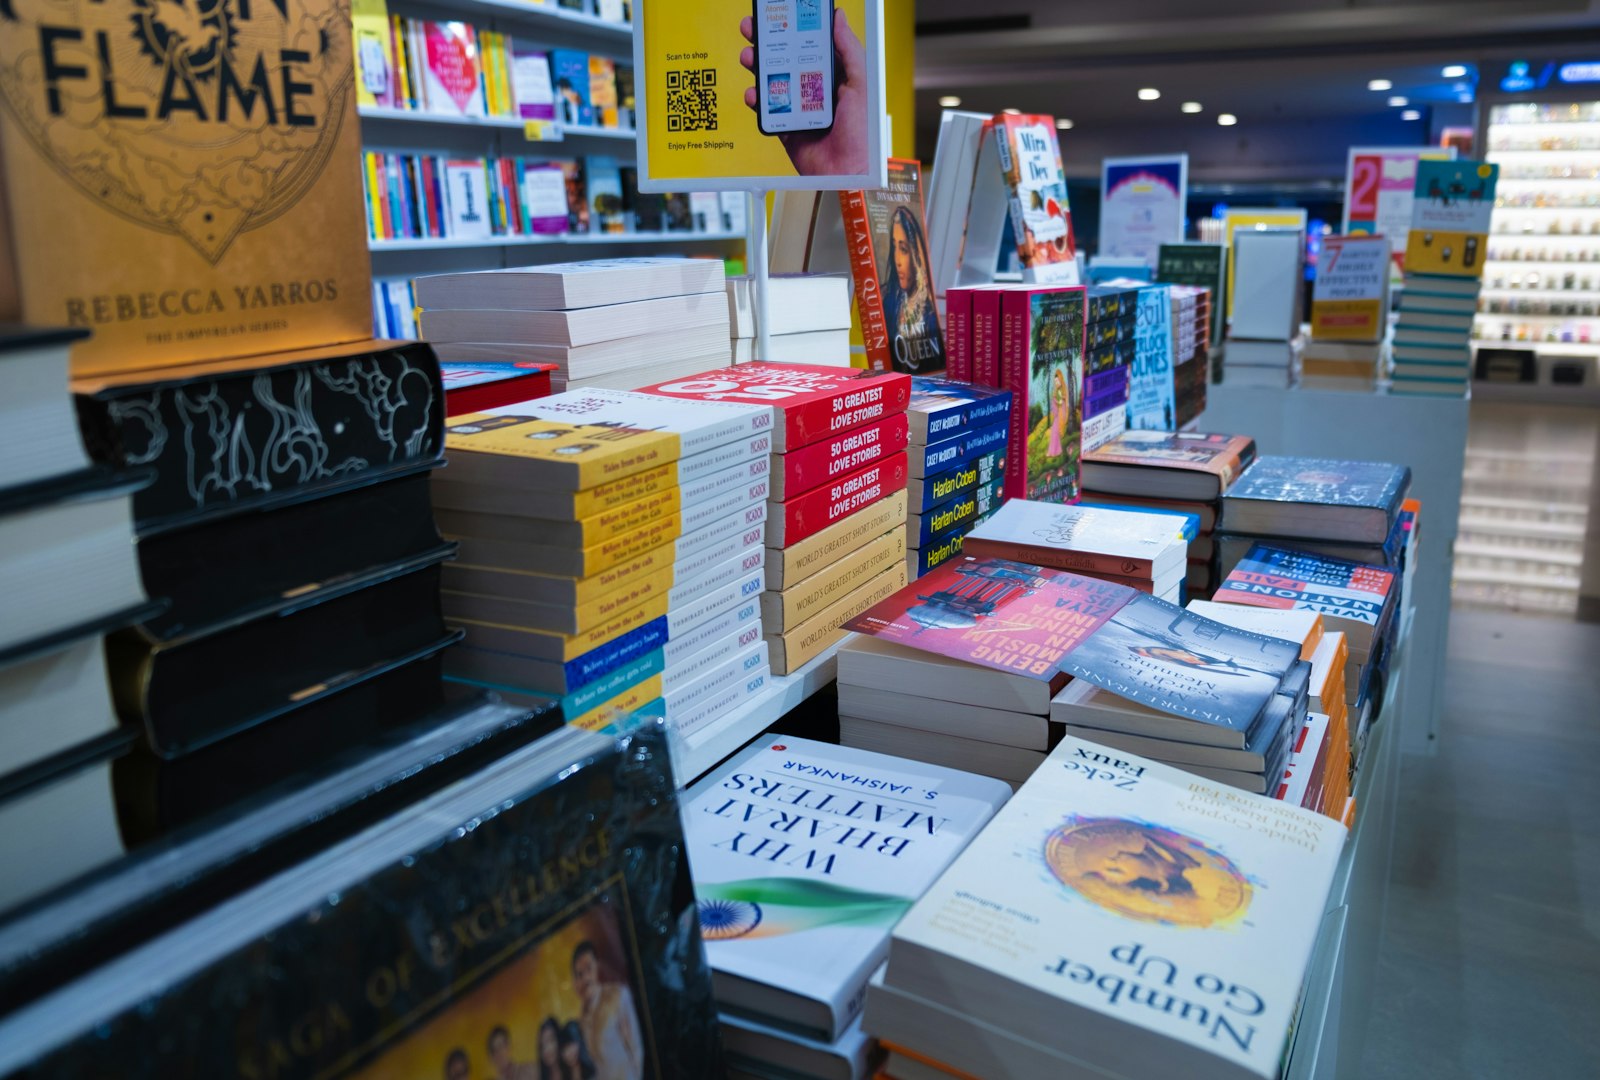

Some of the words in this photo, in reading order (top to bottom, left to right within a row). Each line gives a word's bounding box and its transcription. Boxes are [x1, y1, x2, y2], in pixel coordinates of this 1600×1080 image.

[666, 53, 683, 61] Scan
[692, 51, 708, 61] shop
[39, 25, 316, 126] FLAME
[668, 142, 686, 151] Enjoy
[687, 141, 703, 149] Free
[704, 140, 734, 150] Shipping
[1021, 132, 1046, 152] Mira
[1029, 162, 1048, 180] Dev
[1351, 161, 1378, 213] 2
[853, 218, 873, 268] LAST
[864, 278, 886, 349] QUEEN
[66, 289, 224, 327] REBECCA
[234, 279, 338, 309] YARROS
[895, 335, 940, 370] QUEEN
[1132, 351, 1168, 378] OLMES
[833, 398, 843, 412] 50
[844, 387, 883, 409] GREATEST
[752, 412, 770, 430] PICADOR
[830, 414, 852, 430] LOVE
[853, 403, 883, 423] STORIES
[930, 418, 942, 433] CASEY
[751, 436, 768, 453] PICADOR
[831, 443, 841, 457] 50
[842, 428, 880, 452] GREATEST
[1012, 392, 1020, 476] ENCHANTMENTS
[603, 461, 620, 474] Tales
[621, 457, 635, 469] from
[636, 454, 646, 464] the
[829, 458, 850, 475] LOVE
[852, 444, 882, 466] STORIES
[927, 451, 938, 467] CASEY
[831, 486, 842, 501] 50
[843, 468, 880, 495] GREATEST
[933, 478, 955, 499] Harlan
[956, 469, 976, 489] Coben
[829, 501, 850, 519] LOVE
[852, 484, 881, 508] STORIES
[931, 511, 953, 533] Harlan
[953, 500, 974, 521] Coben
[796, 548, 824, 569] WORLD'S
[824, 532, 852, 559] GREATEST
[852, 523, 870, 541] SHORT
[870, 512, 891, 530] STORIES
[928, 544, 950, 568] Harlan
[1056, 556, 1063, 566] by
[1065, 557, 1096, 569] Gandhi
[1270, 553, 1346, 570] POVERTY
[796, 586, 824, 611] WORLD'S
[824, 570, 851, 596] GREATEST
[852, 560, 870, 577] SHORT
[870, 548, 890, 567] STORIES
[1238, 573, 1299, 588] FAIL
[1269, 569, 1341, 585] ORIGINS
[1279, 560, 1385, 582] PROSPERITY
[1352, 567, 1386, 577] AND
[1363, 579, 1382, 587] OF
[742, 578, 760, 596] PICADOR
[1088, 593, 1114, 607] US
[1230, 582, 1374, 610] NATIONS
[1347, 583, 1381, 592] THE
[738, 605, 754, 622] PICADOR
[800, 626, 827, 650] WORLD'S
[828, 607, 857, 634] GREATEST
[855, 595, 874, 614] SHORT
[873, 582, 893, 602] STORIES
[1031, 604, 1097, 627] INDIA
[1054, 597, 1108, 617] ZIYA
[1298, 604, 1369, 621] WHY
[643, 631, 659, 646] fades
[739, 627, 758, 648] PICADOR
[1010, 612, 1082, 639] HINDU
[961, 630, 1064, 660] MUSLIM
[1044, 635, 1075, 650] IN
[744, 653, 761, 671] PICADOR
[970, 645, 1051, 675] BEING
[1129, 654, 1216, 690] Meaning
[574, 690, 596, 706] Before
[597, 684, 607, 697] the
[608, 674, 626, 690] coffee
[627, 669, 639, 681] gets
[640, 660, 652, 673] cold
[1071, 663, 1138, 697] FRANKL
[1160, 700, 1233, 725] VIKTOR
[1074, 747, 1146, 776] Faux
[782, 760, 913, 794] JAISHANKAR
[1064, 760, 1139, 792] Zeke
[723, 773, 952, 836] MATTERS
[923, 789, 939, 800] S.
[704, 798, 915, 858] BHARAT
[711, 830, 837, 875] WHY
[1110, 943, 1178, 986] Up
[1044, 955, 1257, 1054] Number
[1195, 972, 1266, 1017] Go
